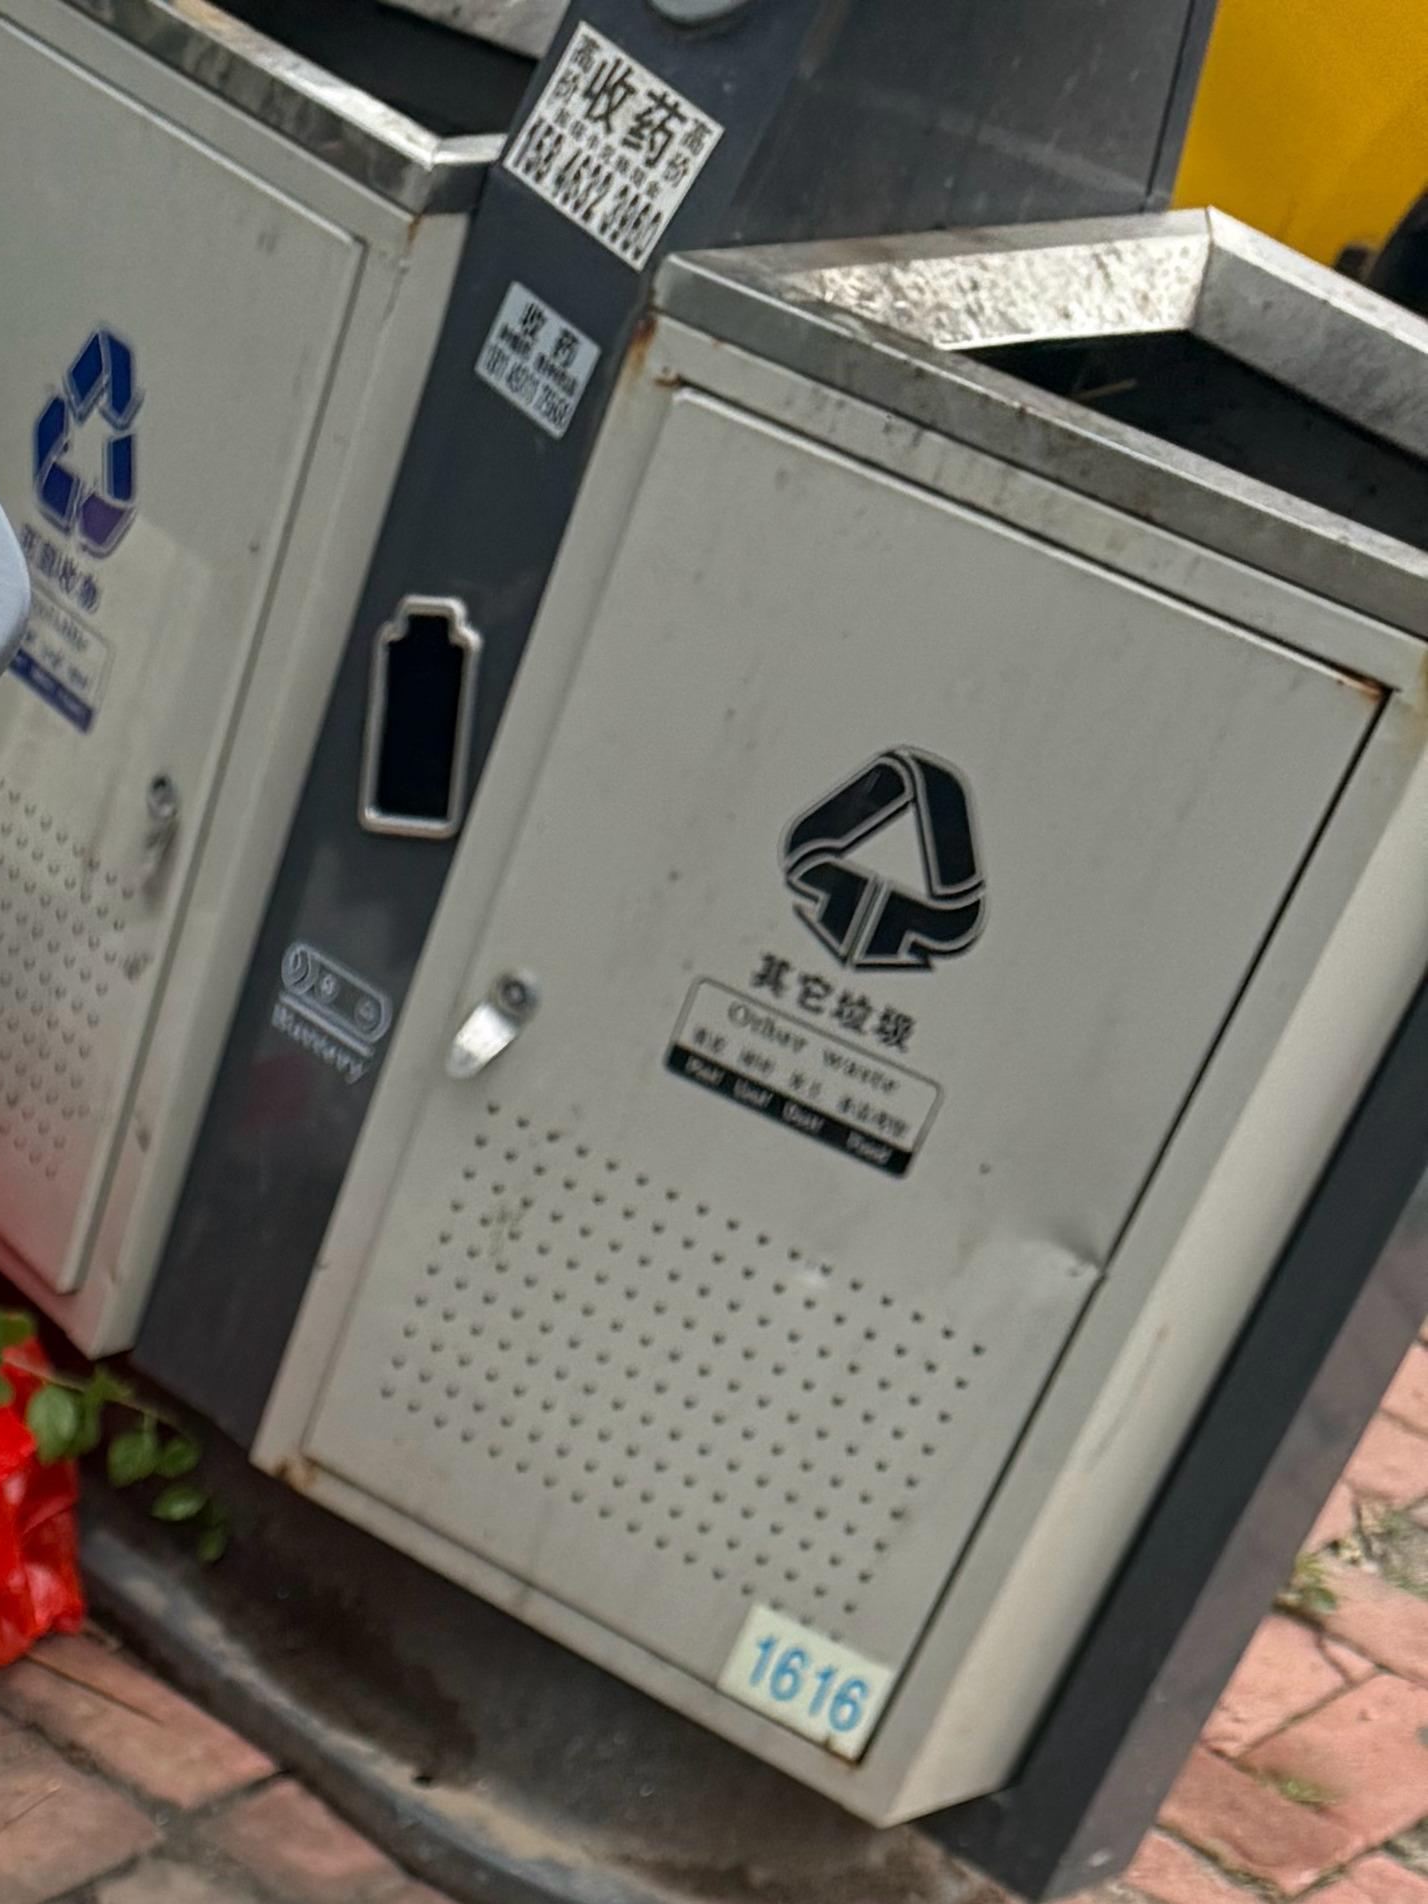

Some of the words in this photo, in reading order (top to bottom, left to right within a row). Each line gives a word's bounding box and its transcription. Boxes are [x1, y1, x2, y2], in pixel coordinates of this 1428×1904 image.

[583, 58, 688, 168] 收药
[750, 953, 916, 1052] 其它垃圾
[749, 1635, 869, 1733] 1616
